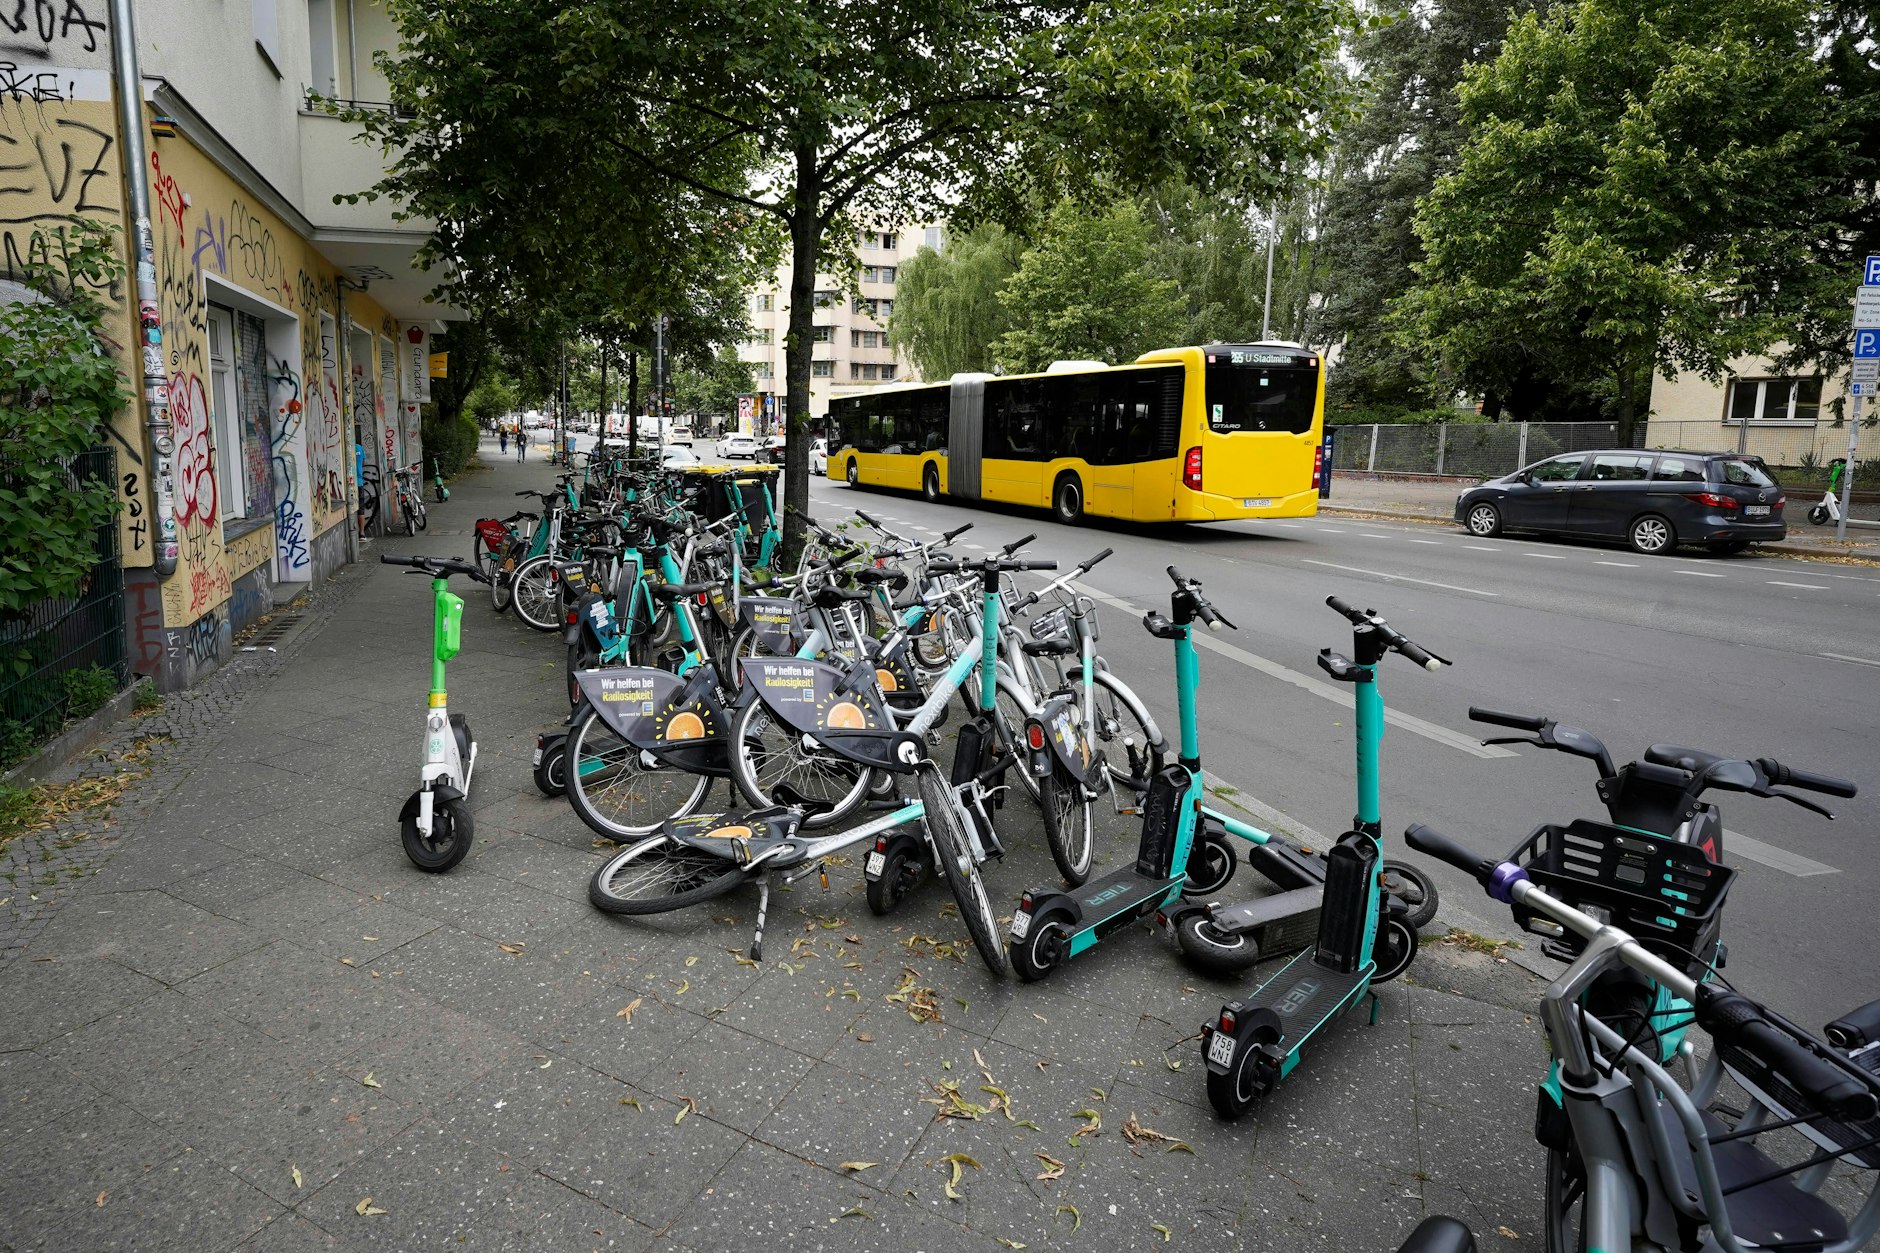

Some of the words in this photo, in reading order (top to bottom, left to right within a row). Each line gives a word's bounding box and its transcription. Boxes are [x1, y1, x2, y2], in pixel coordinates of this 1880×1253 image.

[1859, 332, 1876, 354] P
[1246, 354, 1252, 362] U
[1253, 354, 1292, 364] Stadtmitte
[413, 347, 424, 400] Gundara
[754, 605, 764, 613] Wir
[764, 606, 782, 614] helfen
[754, 614, 791, 624] Radlosigkeit!
[764, 666, 778, 676] Wir
[778, 666, 802, 676] helfen
[802, 666, 814, 677] bei
[602, 678, 615, 690] Wir
[616, 678, 641, 689] helfen
[642, 678, 654, 688] bei
[765, 677, 814, 690] Radlosigkeit!
[602, 690, 654, 702] Radlosigkeit!
[919, 684, 955, 734] nextbike
[1182, 818, 1194, 863] TIER
[871, 852, 883, 864] 397
[1087, 883, 1134, 906] TIER
[1016, 912, 1030, 926] 577
[1281, 982, 1319, 1013] TIER
[1214, 1034, 1232, 1052] 758
[1211, 1046, 1228, 1065] WNI
